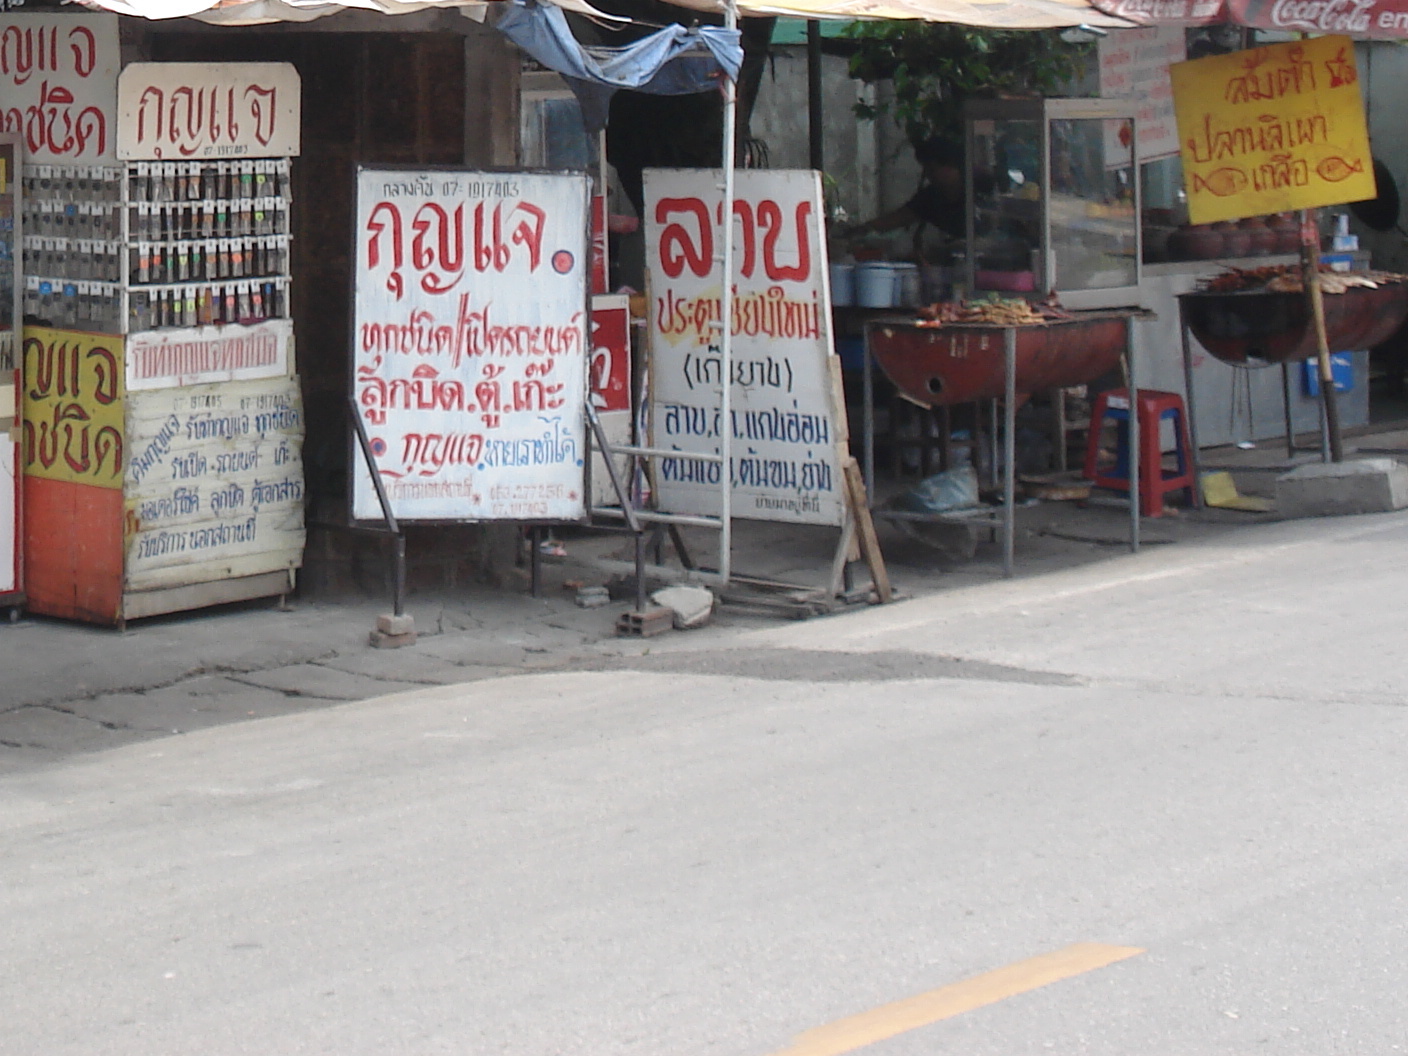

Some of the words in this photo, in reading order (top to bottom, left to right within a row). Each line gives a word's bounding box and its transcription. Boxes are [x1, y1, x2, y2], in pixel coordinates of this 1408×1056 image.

[1224, 45, 1317, 105] ส้มตำ
[138, 83, 278, 160] กุญแจ
[1252, 152, 1309, 192] เกลือ
[365, 199, 548, 302] กุญแจ
[655, 196, 812, 282] ลาบ
